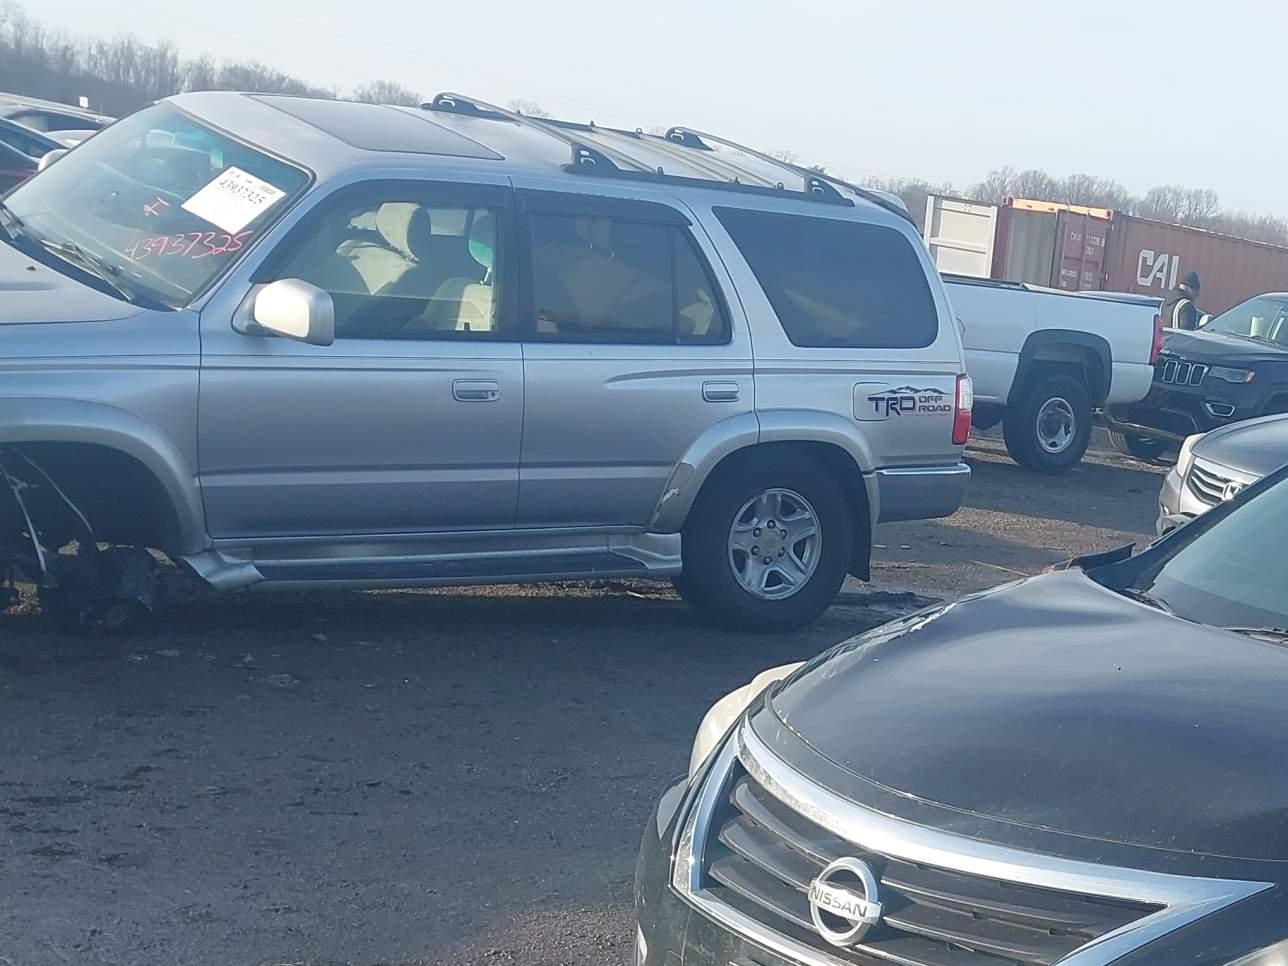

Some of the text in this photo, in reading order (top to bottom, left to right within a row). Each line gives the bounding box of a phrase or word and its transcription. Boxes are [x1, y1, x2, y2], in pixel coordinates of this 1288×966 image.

[124, 230, 253, 260] 43937325
[1136, 248, 1180, 290] CAI
[867, 395, 916, 417] TRD
[918, 395, 943, 403] OFF
[918, 404, 952, 412] ROAD
[810, 885, 868, 918] NISSAN
